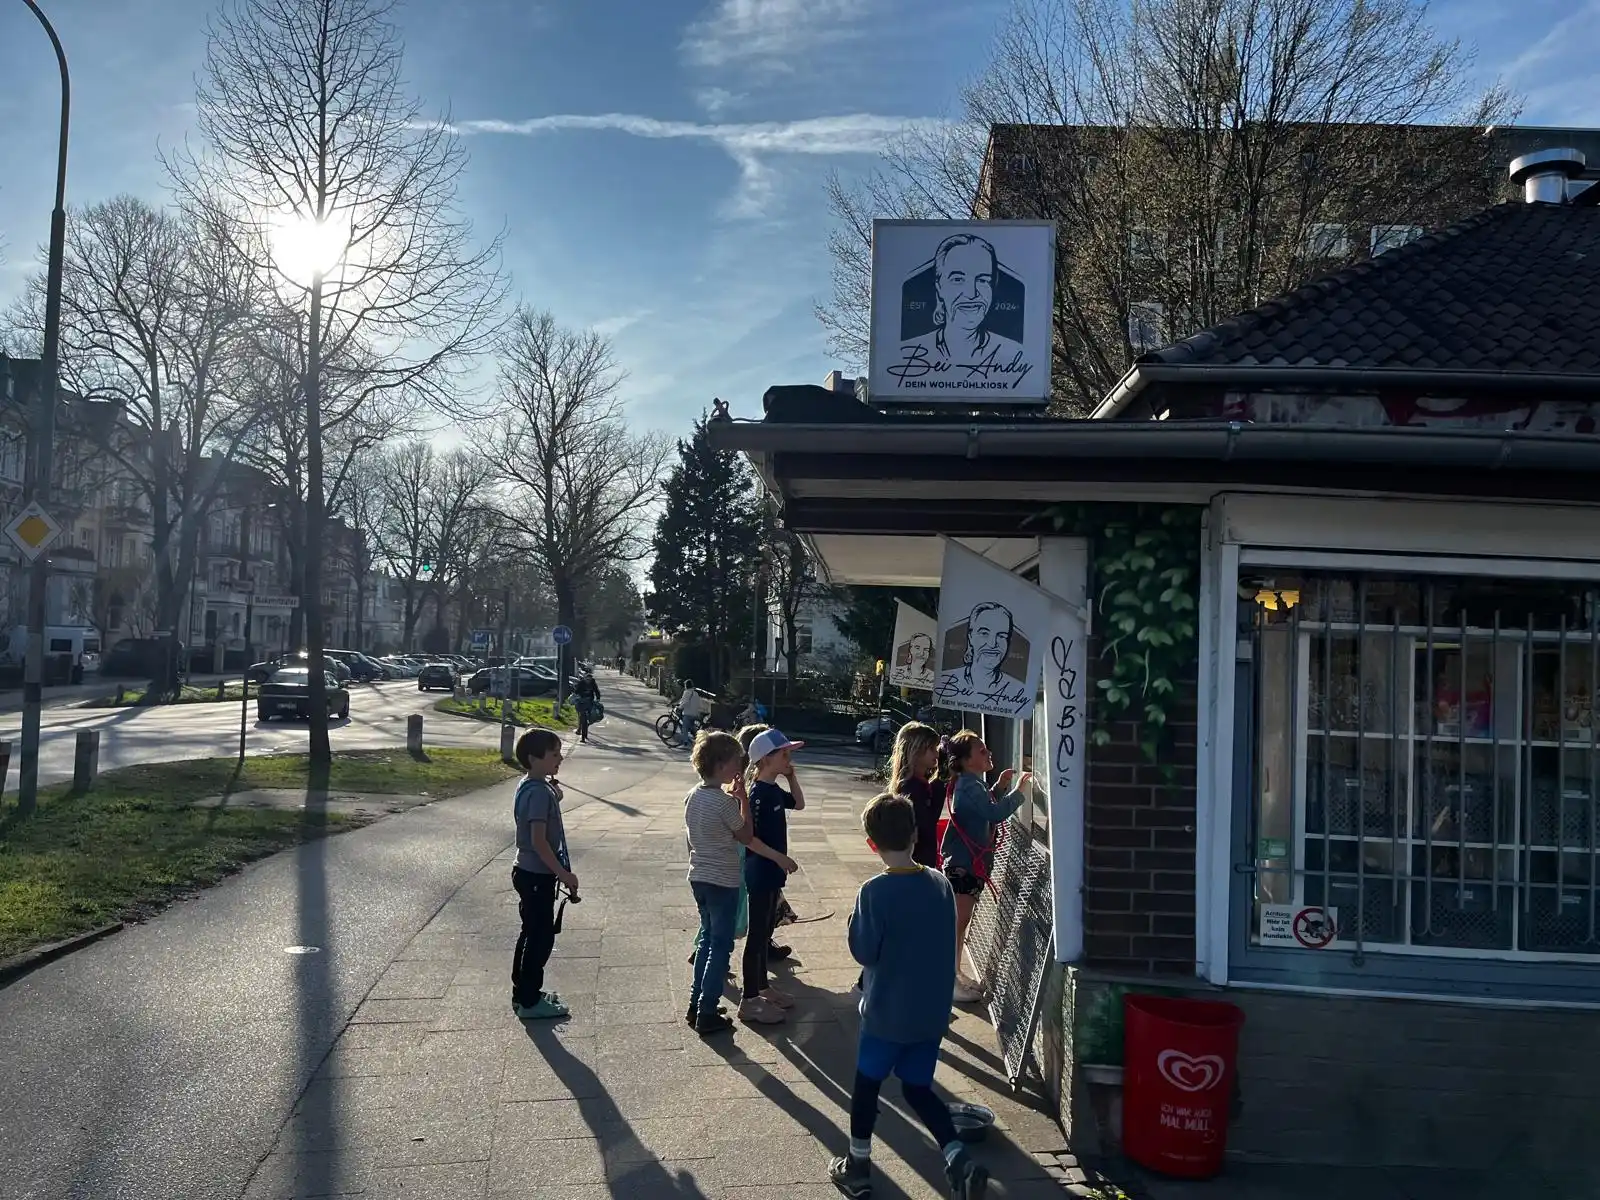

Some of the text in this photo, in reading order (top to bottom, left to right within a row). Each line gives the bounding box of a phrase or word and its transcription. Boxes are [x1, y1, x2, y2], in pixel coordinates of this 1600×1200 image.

[910, 301, 926, 310] EST
[887, 344, 1033, 389] Bei Andy
[929, 380, 1008, 389] WOHLFÜHLKIOSK
[934, 674, 1031, 714] Bei Andy
[957, 701, 1012, 714] WOHLFÜHLKIOSK
[1160, 1113, 1182, 1129] MAL
